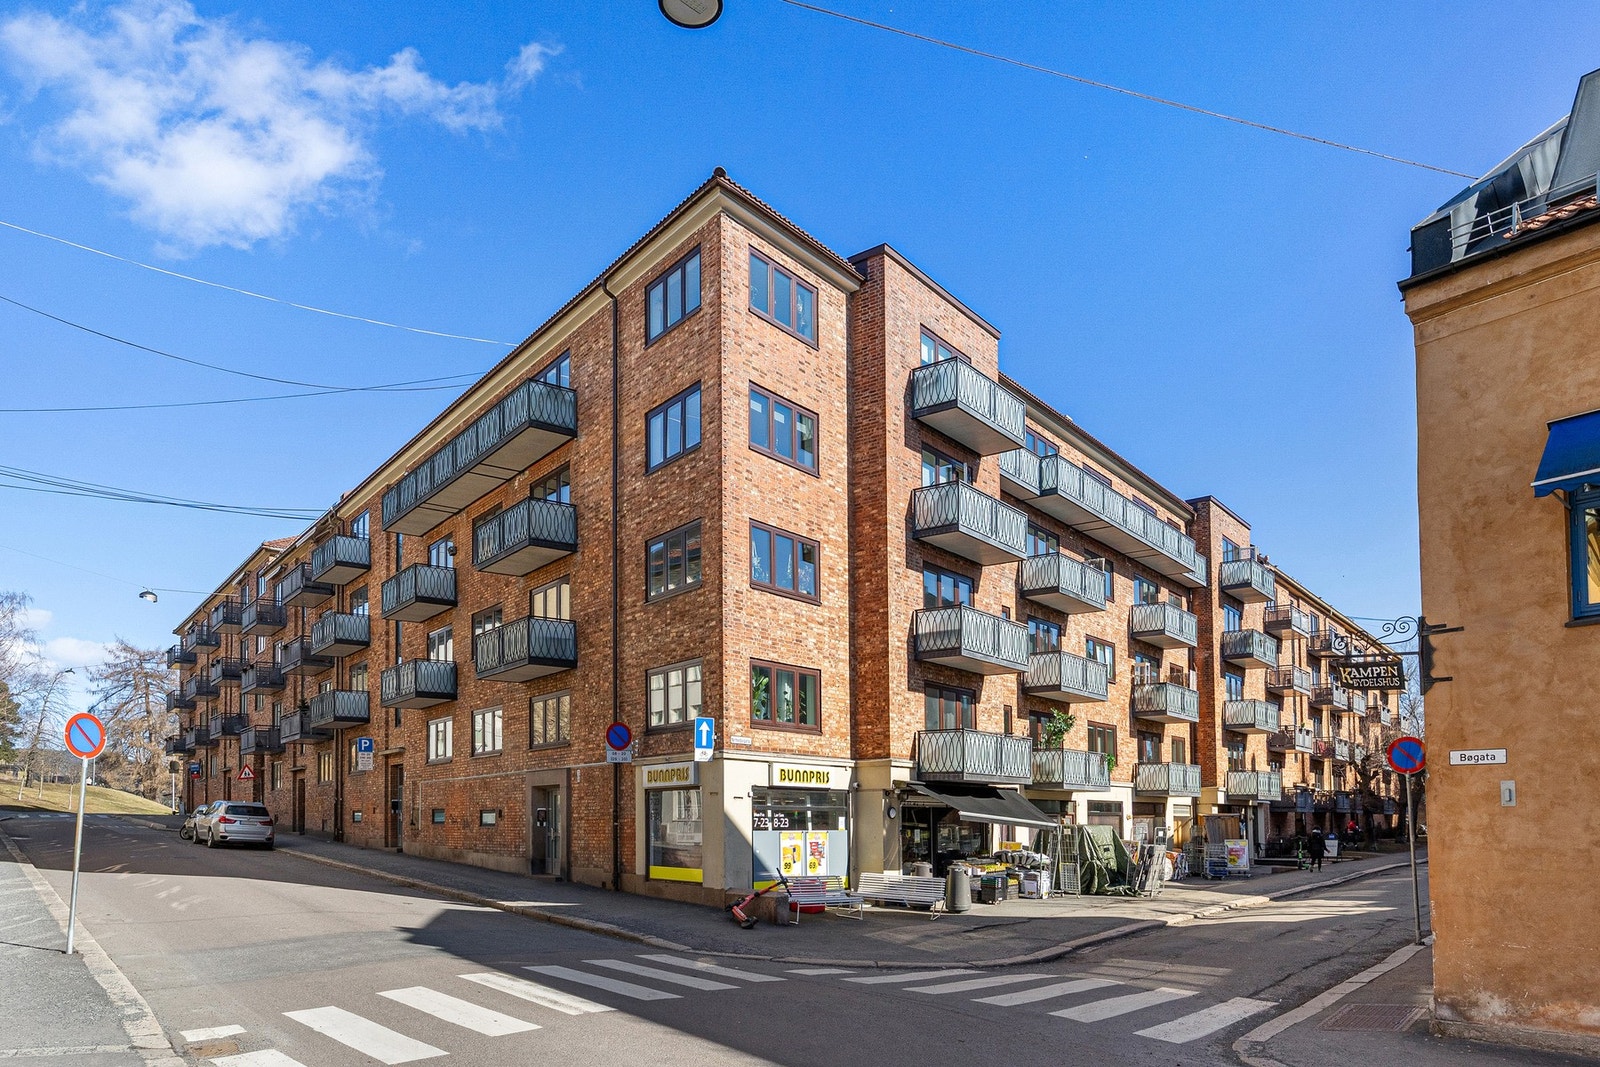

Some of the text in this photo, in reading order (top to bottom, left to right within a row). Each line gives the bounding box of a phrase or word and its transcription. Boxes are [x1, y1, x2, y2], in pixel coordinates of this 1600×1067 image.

[1340, 666, 1398, 684] KAMPEN
[1353, 677, 1400, 687] BYDELSHUS
[361, 739, 370, 751] P
[1460, 753, 1496, 763] Bøgata
[647, 766, 689, 782] BUNNPRIS
[779, 768, 830, 784] BUNNPRIS
[753, 817, 769, 828] 7-23
[773, 817, 789, 828] 8-23
